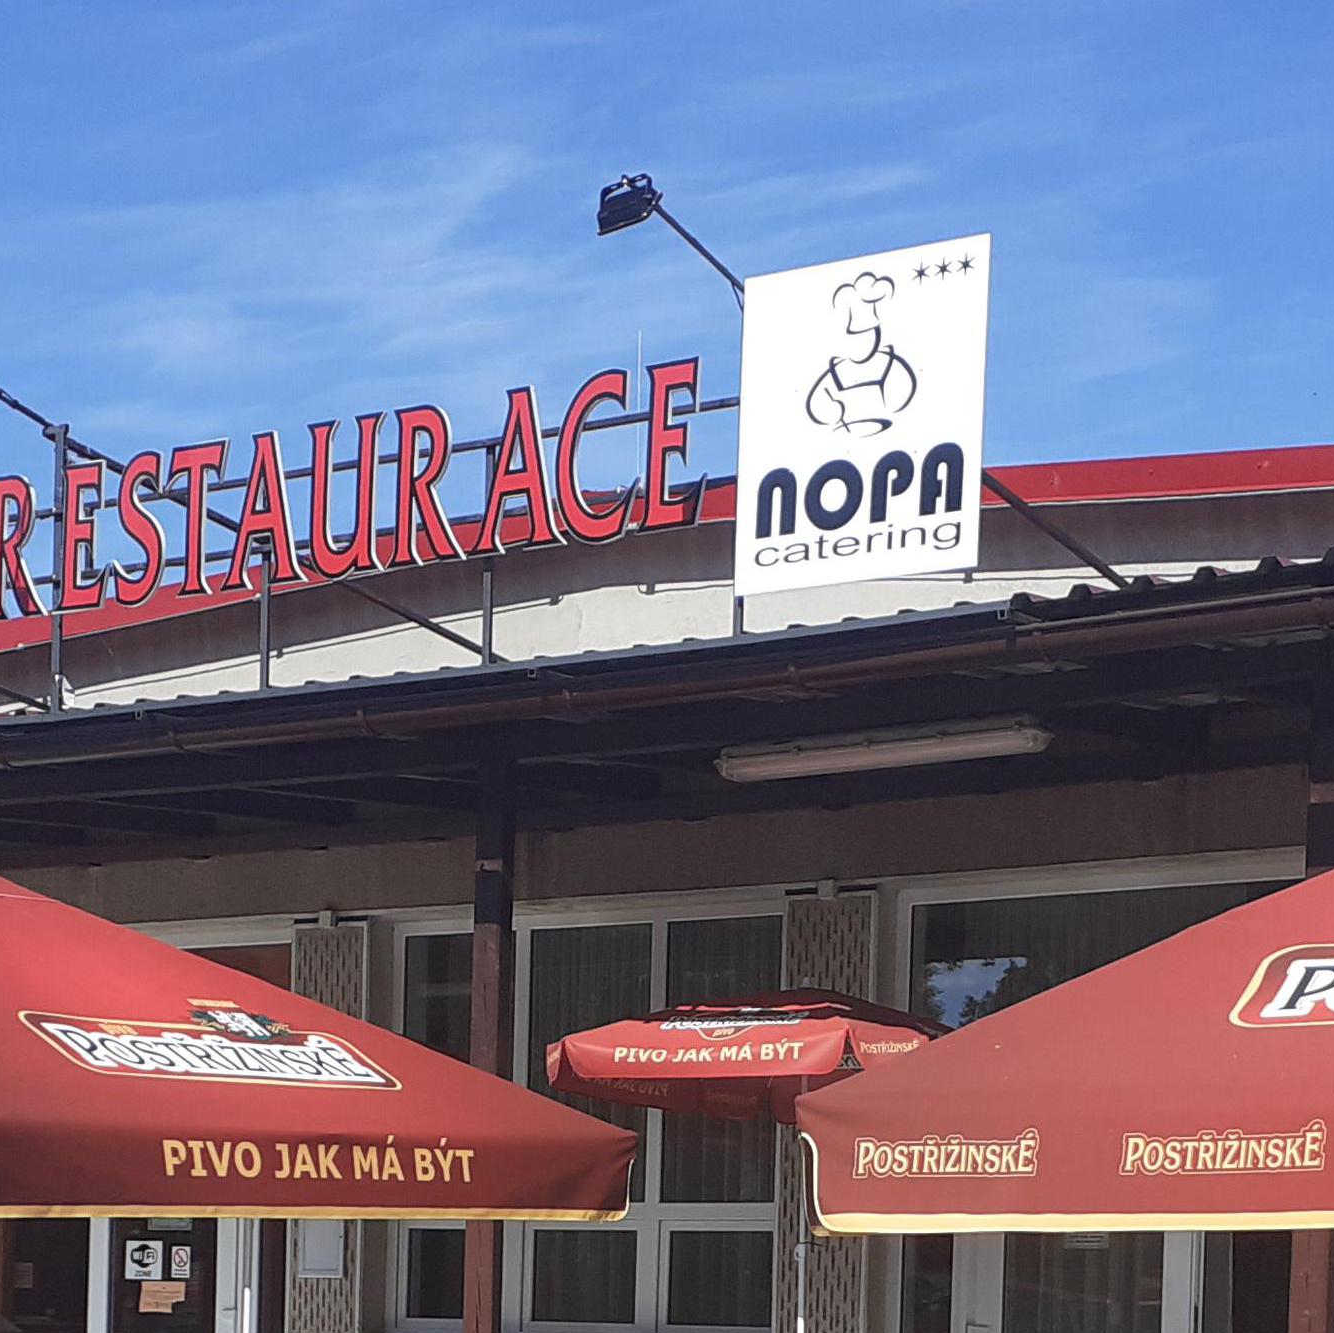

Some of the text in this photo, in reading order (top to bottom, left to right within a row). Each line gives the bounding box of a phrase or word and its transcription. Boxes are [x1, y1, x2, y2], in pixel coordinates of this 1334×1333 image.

[755, 441, 964, 539] NOPA
[753, 521, 962, 567] catering
[53, 1026, 374, 1079] POSTŘIŽINSKÉ
[614, 1038, 804, 1063] PIVO JAK MÁ BÝT
[712, 1028, 735, 1038] pivo
[162, 1134, 475, 1183] PIVO JAK MÁ BÝT
[855, 1130, 1038, 1177] POSTŘIŽINSKÉ
[1122, 1120, 1324, 1174] POSTŘIŽINSKÉ
